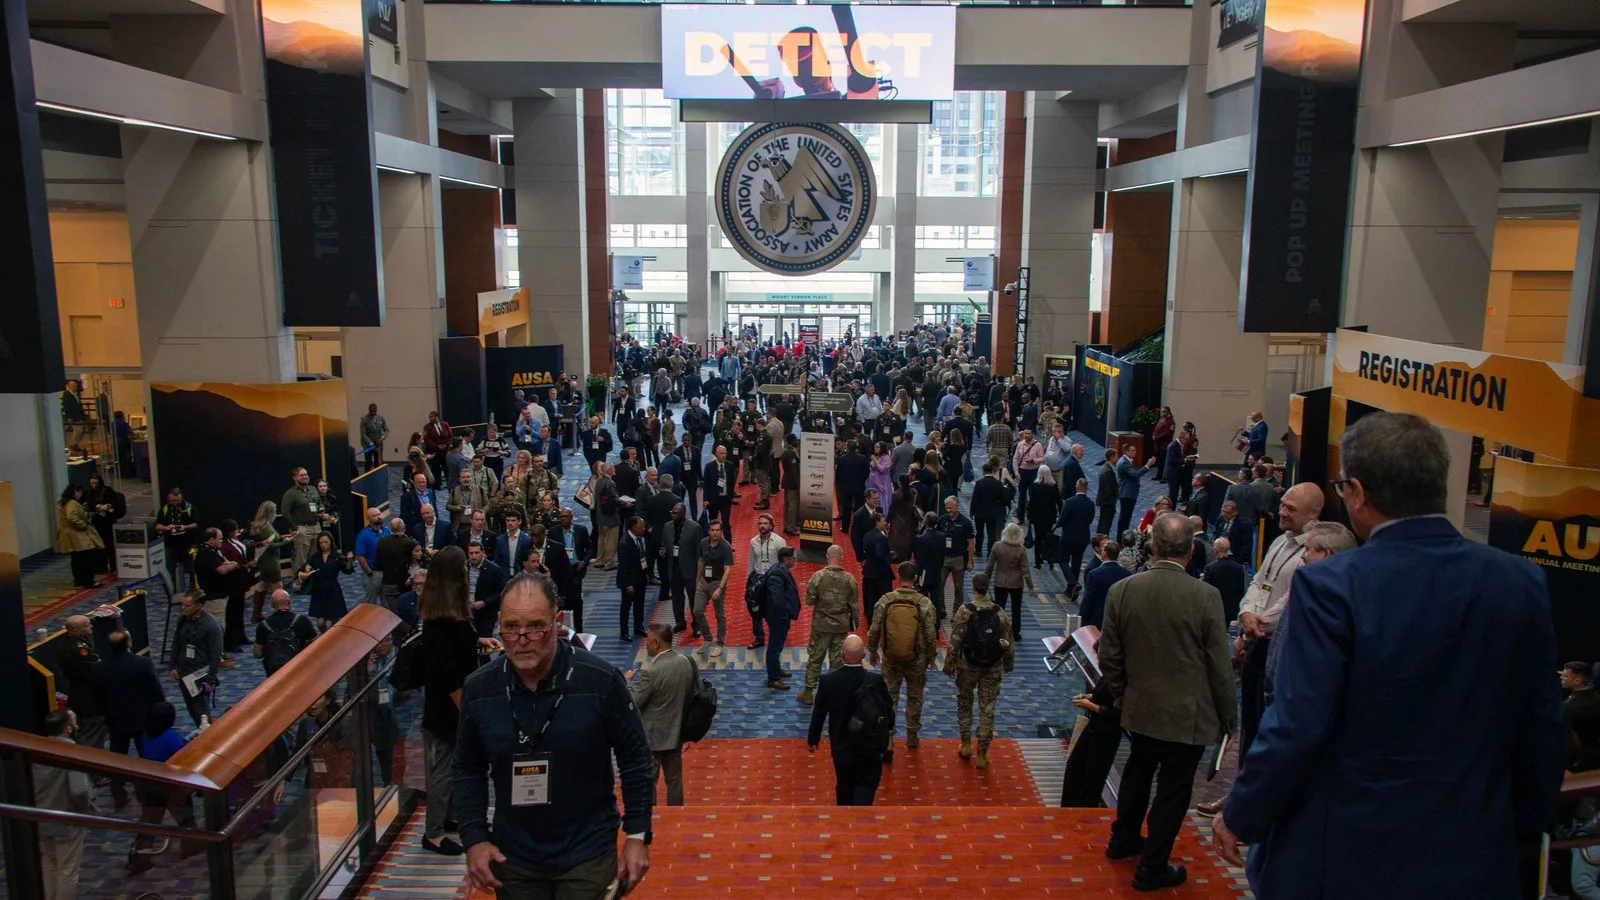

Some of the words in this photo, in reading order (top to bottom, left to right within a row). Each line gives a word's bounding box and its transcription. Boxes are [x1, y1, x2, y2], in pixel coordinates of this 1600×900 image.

[684, 31, 933, 78] DETECT
[763, 136, 790, 155] THE
[797, 136, 842, 169] UNITED
[1291, 84, 1317, 191] MEETING
[748, 153, 763, 172] OF
[306, 142, 339, 259] TICKET
[738, 174, 790, 254] ASSOCIATION
[836, 172, 854, 223] STATES
[1289, 197, 1308, 230] UP
[804, 223, 839, 254] ARMY
[1285, 235, 1305, 283] POP
[492, 300, 520, 316] REGISTRATION
[511, 371, 554, 386] AUSA
[1050, 358, 1068, 366] AUSA
[1358, 350, 1508, 412] REGISTRATION
[803, 519, 830, 530] AUSA
[1562, 561, 1600, 573] MEETIN
